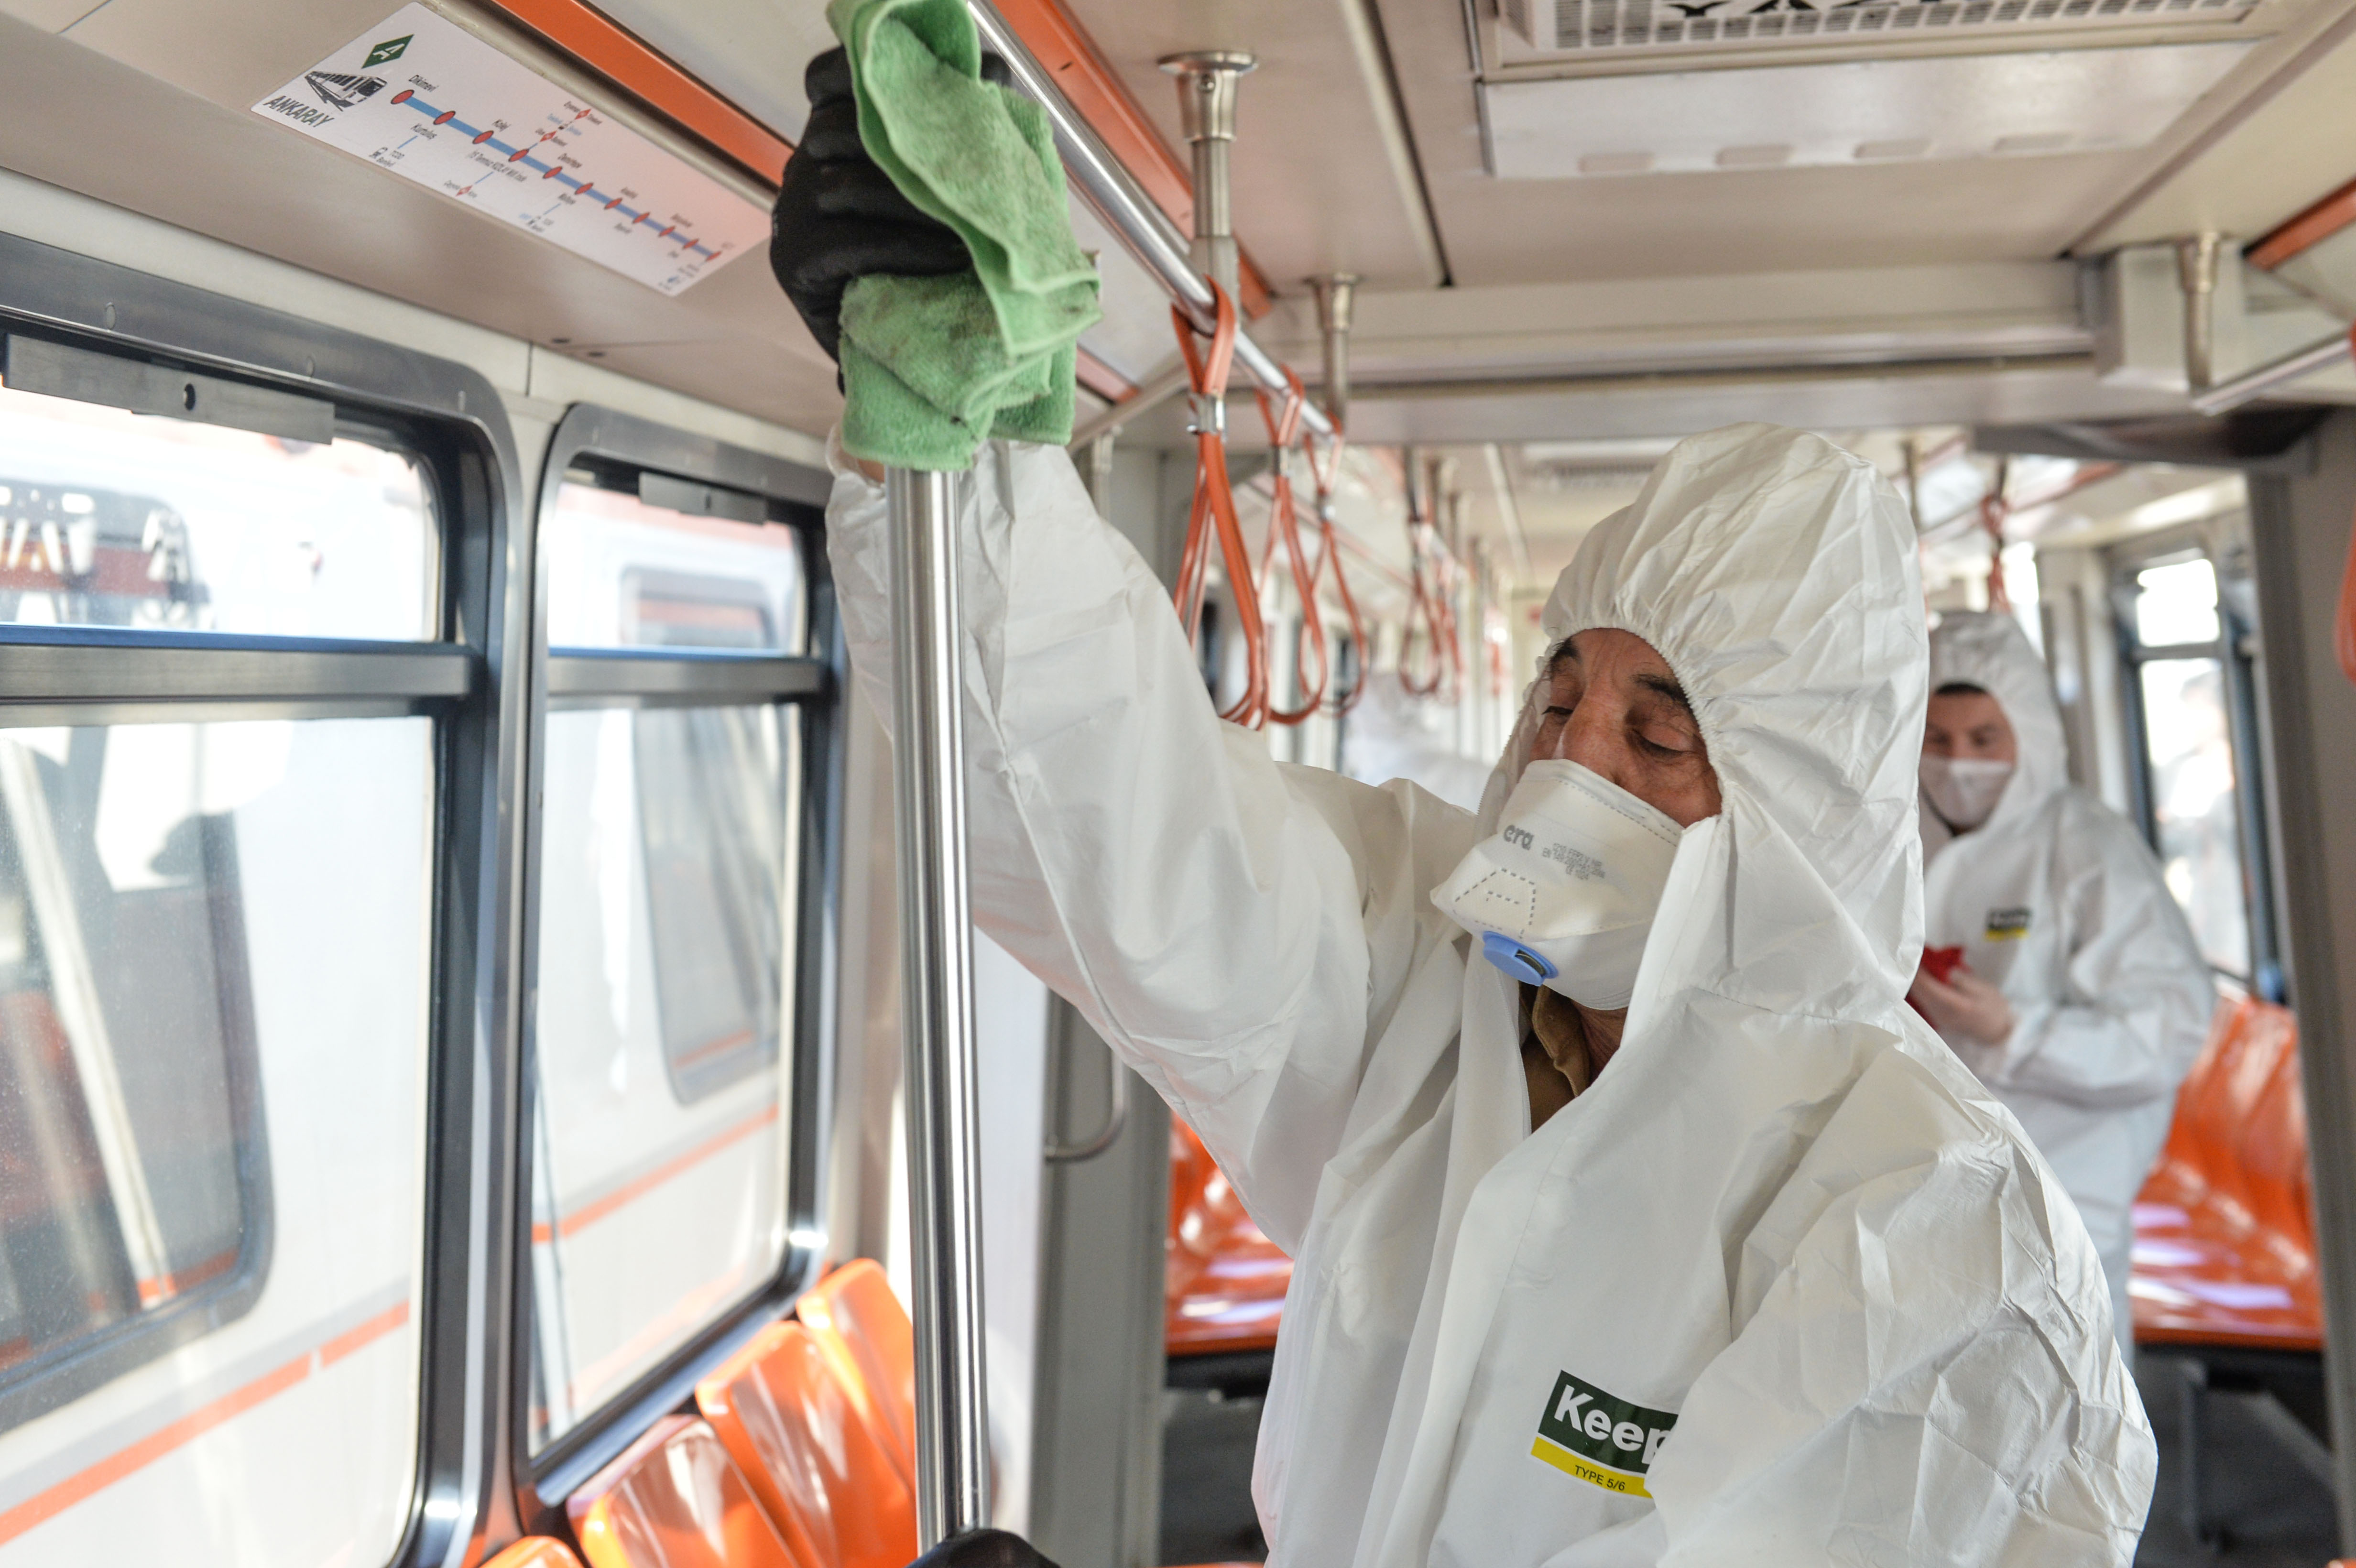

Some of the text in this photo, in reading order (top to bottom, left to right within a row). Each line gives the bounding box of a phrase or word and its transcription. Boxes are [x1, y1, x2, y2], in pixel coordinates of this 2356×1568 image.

[408, 75, 438, 92] Dikimevi
[263, 96, 334, 127] ANKARAY
[492, 119, 511, 132] Kolej
[1504, 825, 1534, 850] era
[1575, 1465, 1625, 1492] TYPE 5/6
